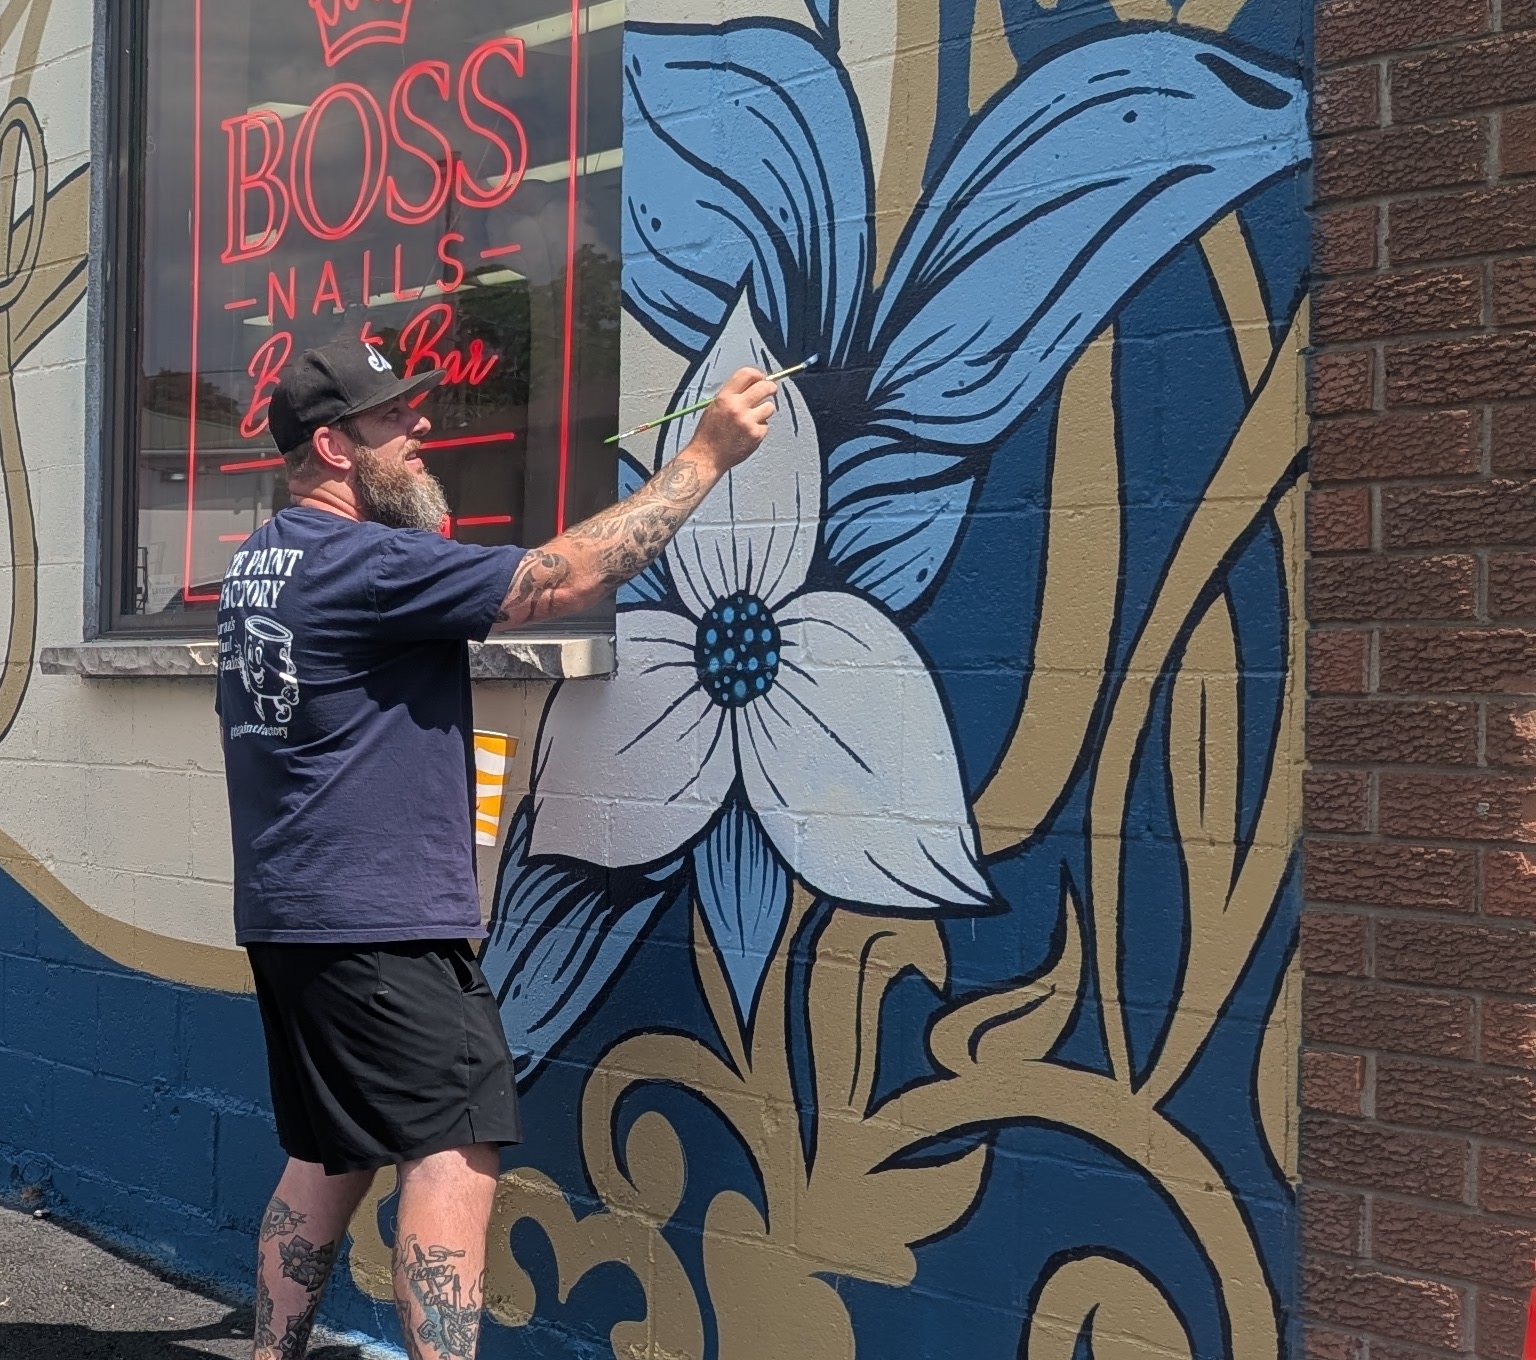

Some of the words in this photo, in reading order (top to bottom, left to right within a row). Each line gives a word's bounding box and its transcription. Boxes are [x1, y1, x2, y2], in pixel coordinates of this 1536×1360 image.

[221, 36, 528, 264] BOSS
[266, 233, 464, 324] NAILS
[399, 302, 499, 409] Bar
[244, 547, 305, 577] PAINT
